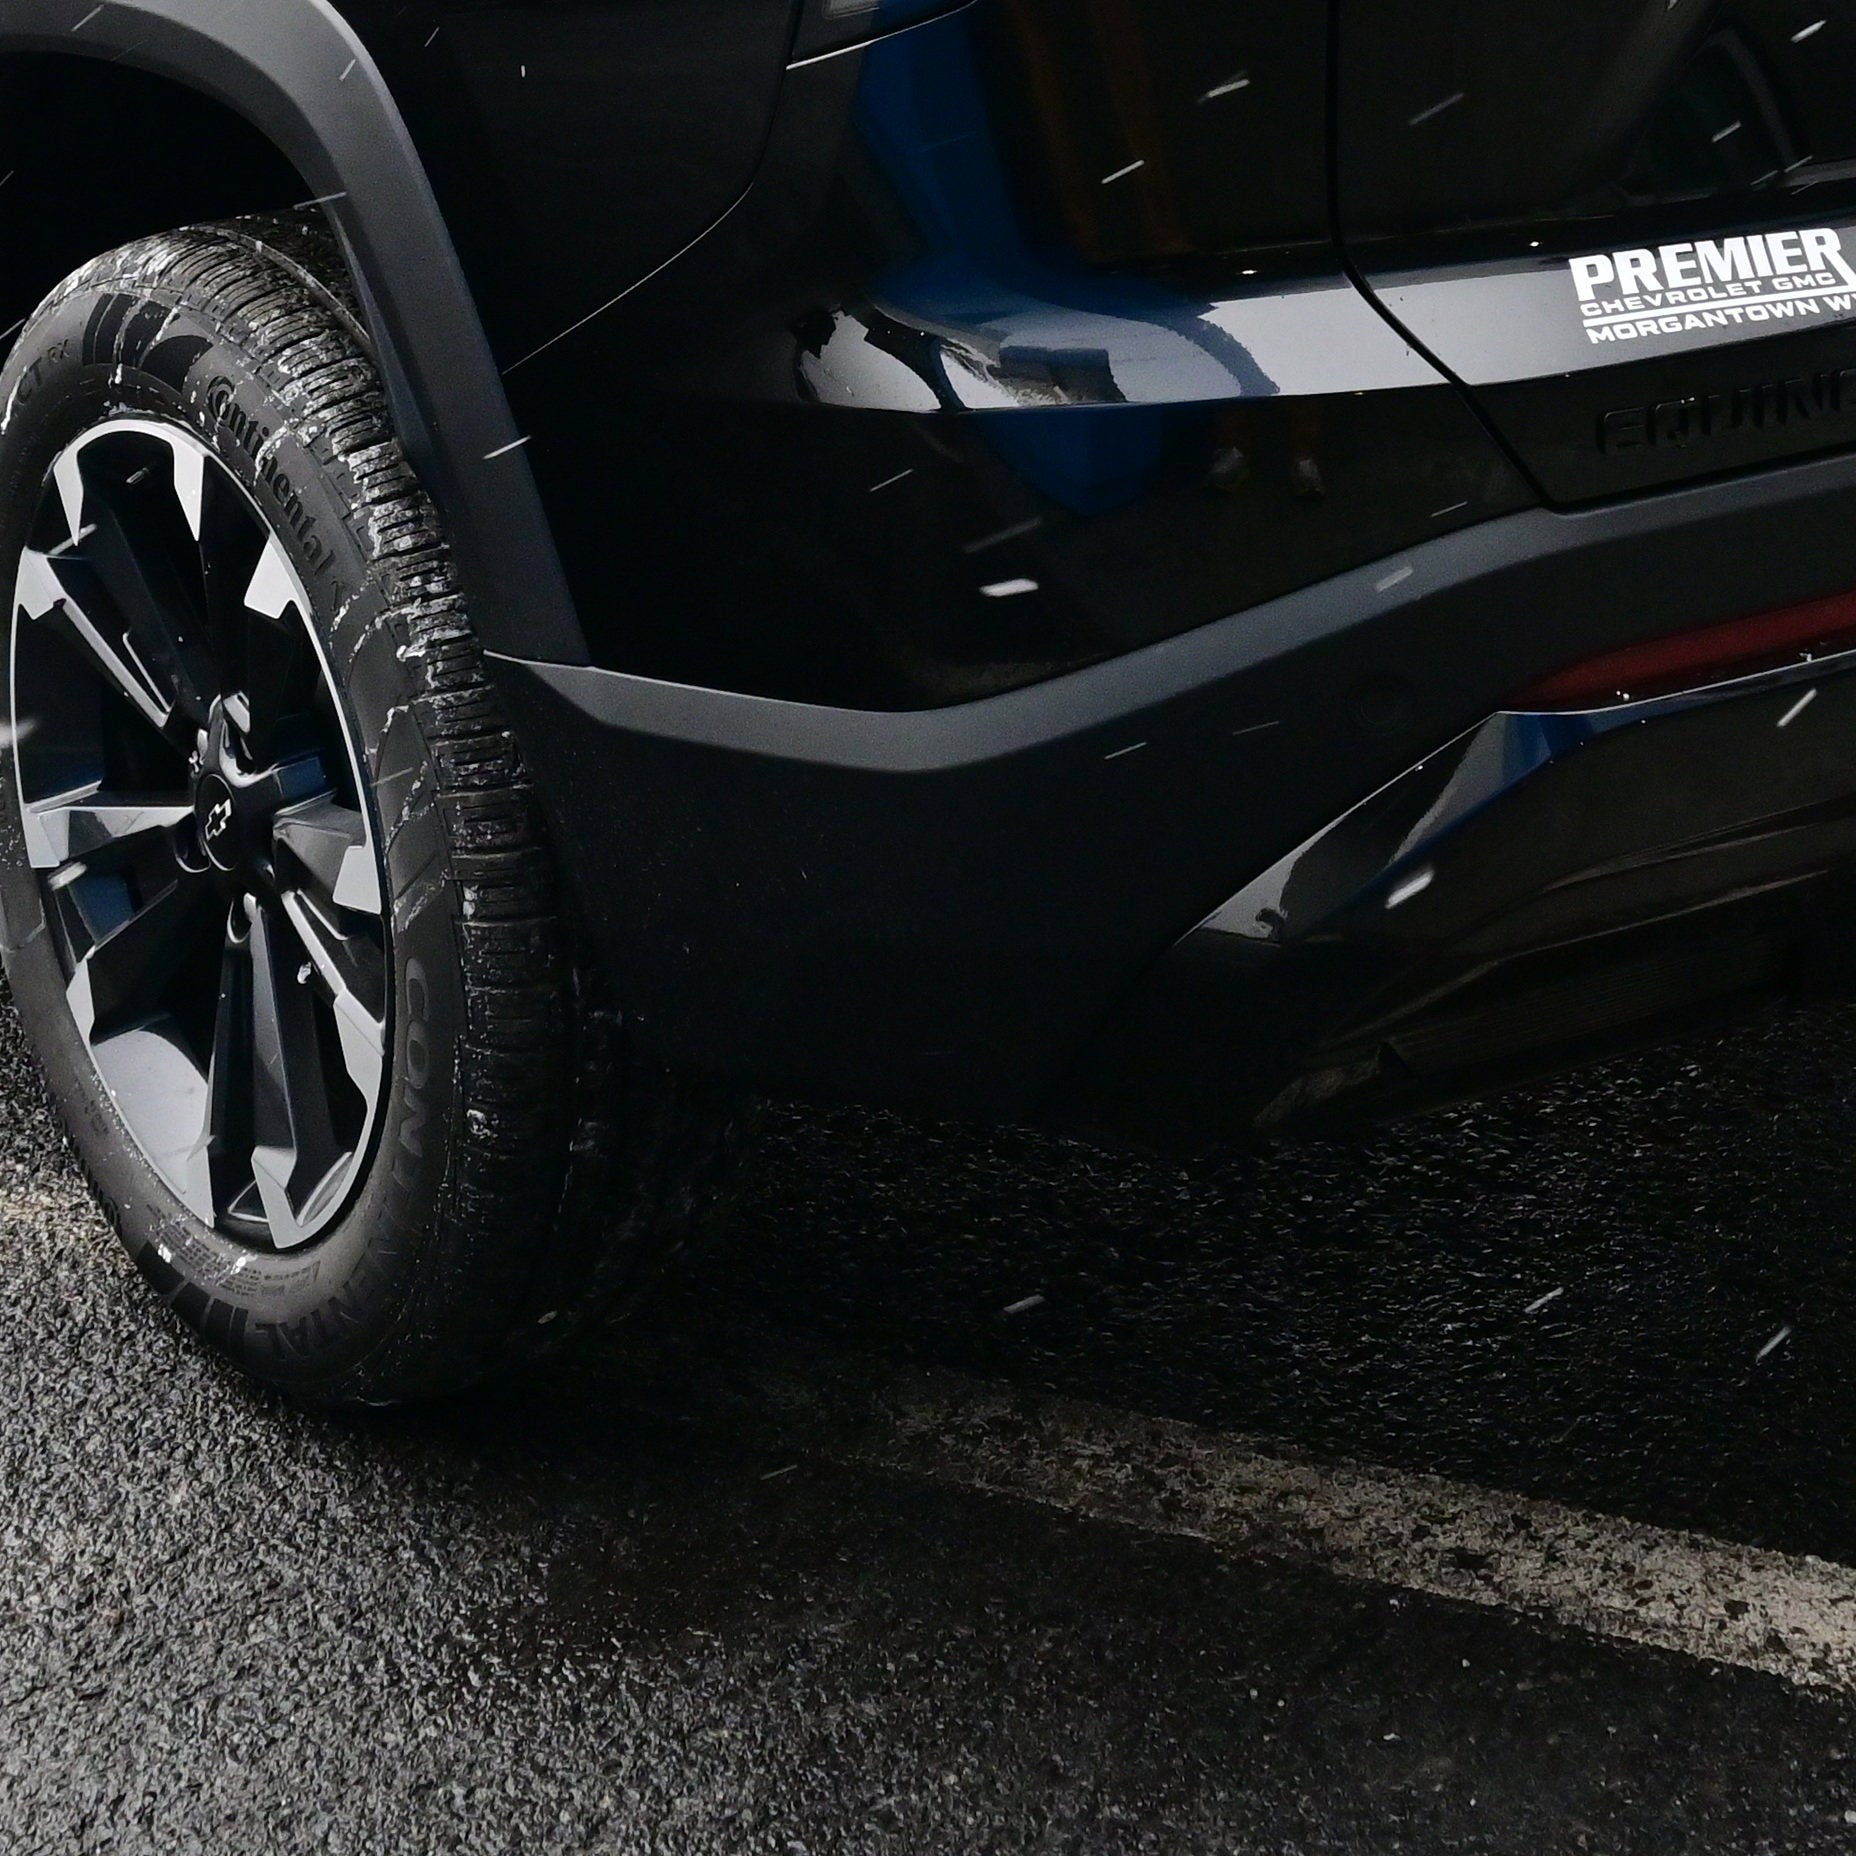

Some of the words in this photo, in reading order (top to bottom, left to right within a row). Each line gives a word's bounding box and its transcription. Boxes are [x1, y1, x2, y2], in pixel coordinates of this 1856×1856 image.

[1568, 227, 1856, 302] PREMIER
[1580, 279, 1763, 317] CHEVROLET
[1772, 271, 1836, 290] GMC
[1586, 298, 1821, 344] MORGANTOWN
[207, 375, 336, 576] Continental
